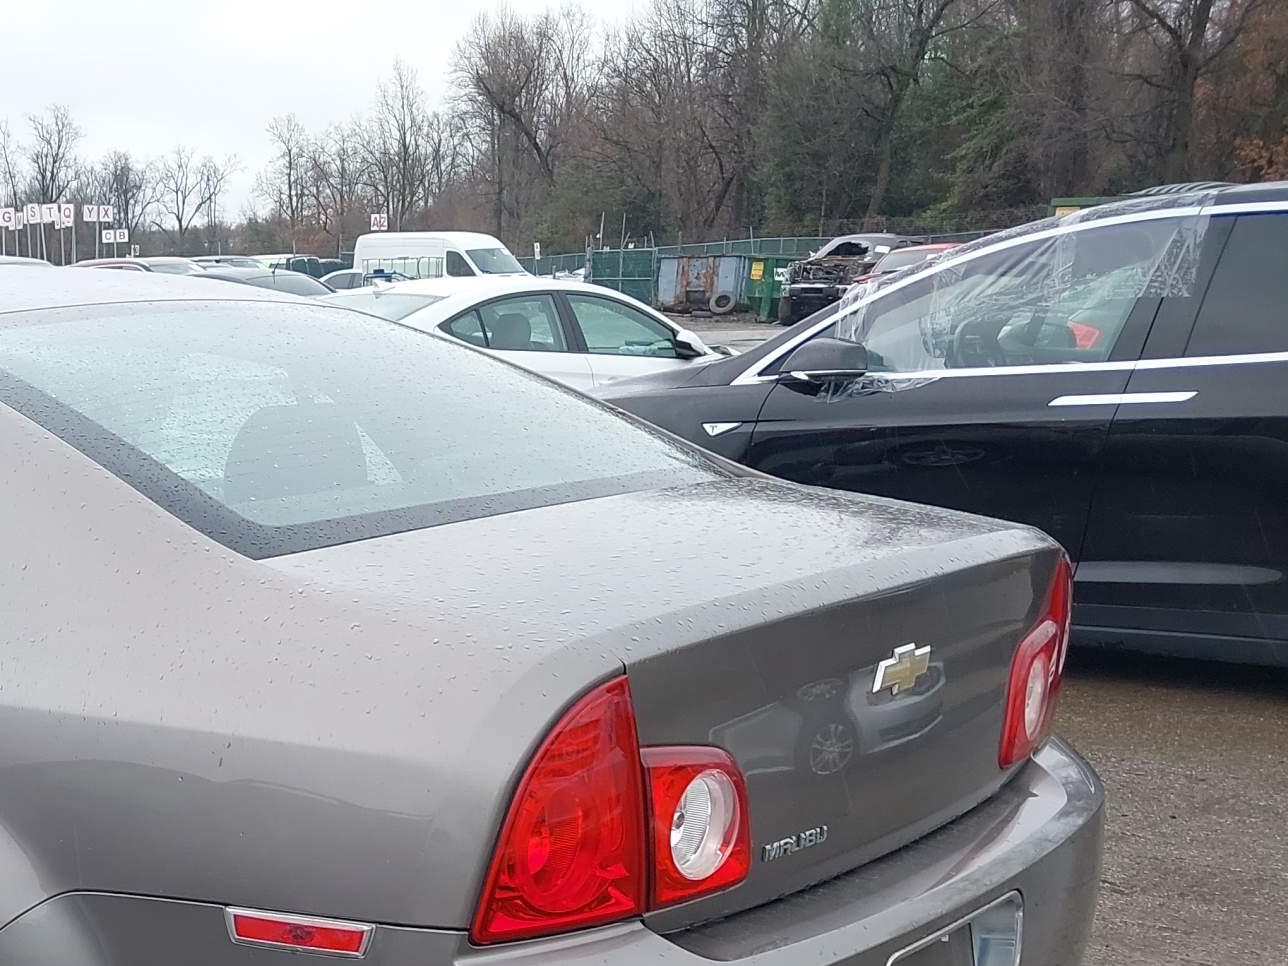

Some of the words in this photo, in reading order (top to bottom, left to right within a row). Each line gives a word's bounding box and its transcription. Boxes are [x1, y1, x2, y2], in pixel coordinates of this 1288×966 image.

[2, 211, 12, 222] G
[46, 206, 54, 218] T
[87, 206, 94, 218] Y
[103, 206, 110, 219] X
[104, 231, 112, 241] C
[118, 231, 126, 240] B
[762, 825, 828, 863] MALIBU
